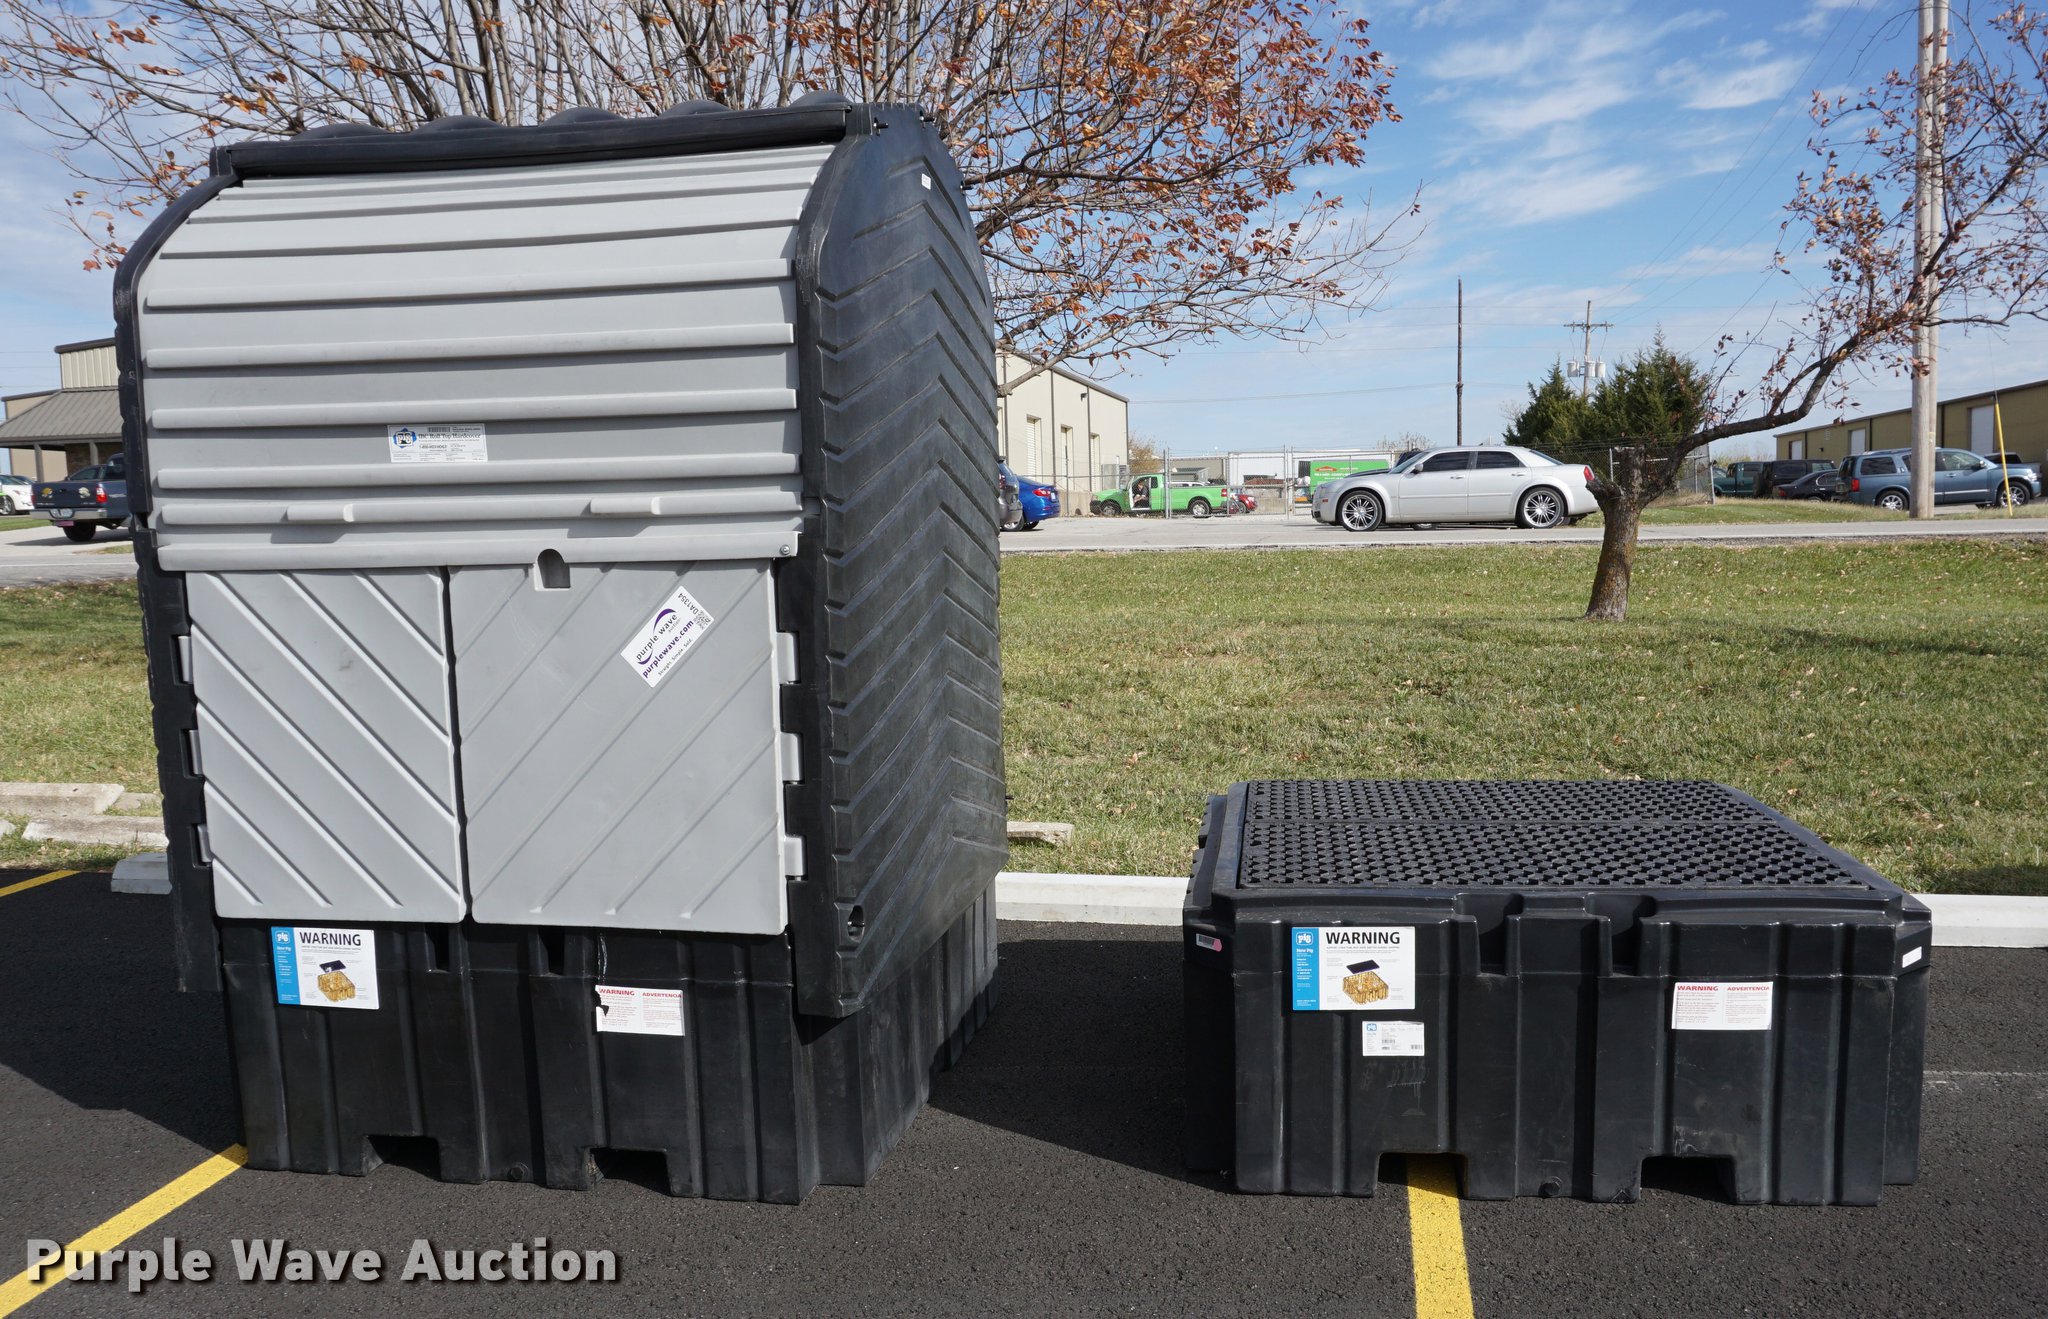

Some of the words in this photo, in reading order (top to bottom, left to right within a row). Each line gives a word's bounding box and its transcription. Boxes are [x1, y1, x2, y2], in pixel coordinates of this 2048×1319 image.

[678, 593, 699, 615] DA1354
[636, 634, 659, 661] purple
[658, 614, 677, 635] wave
[642, 620, 694, 679] purplewave.com
[299, 931, 361, 946] WARNING
[1325, 931, 1400, 945] WARNING
[599, 988, 635, 996] WARNING
